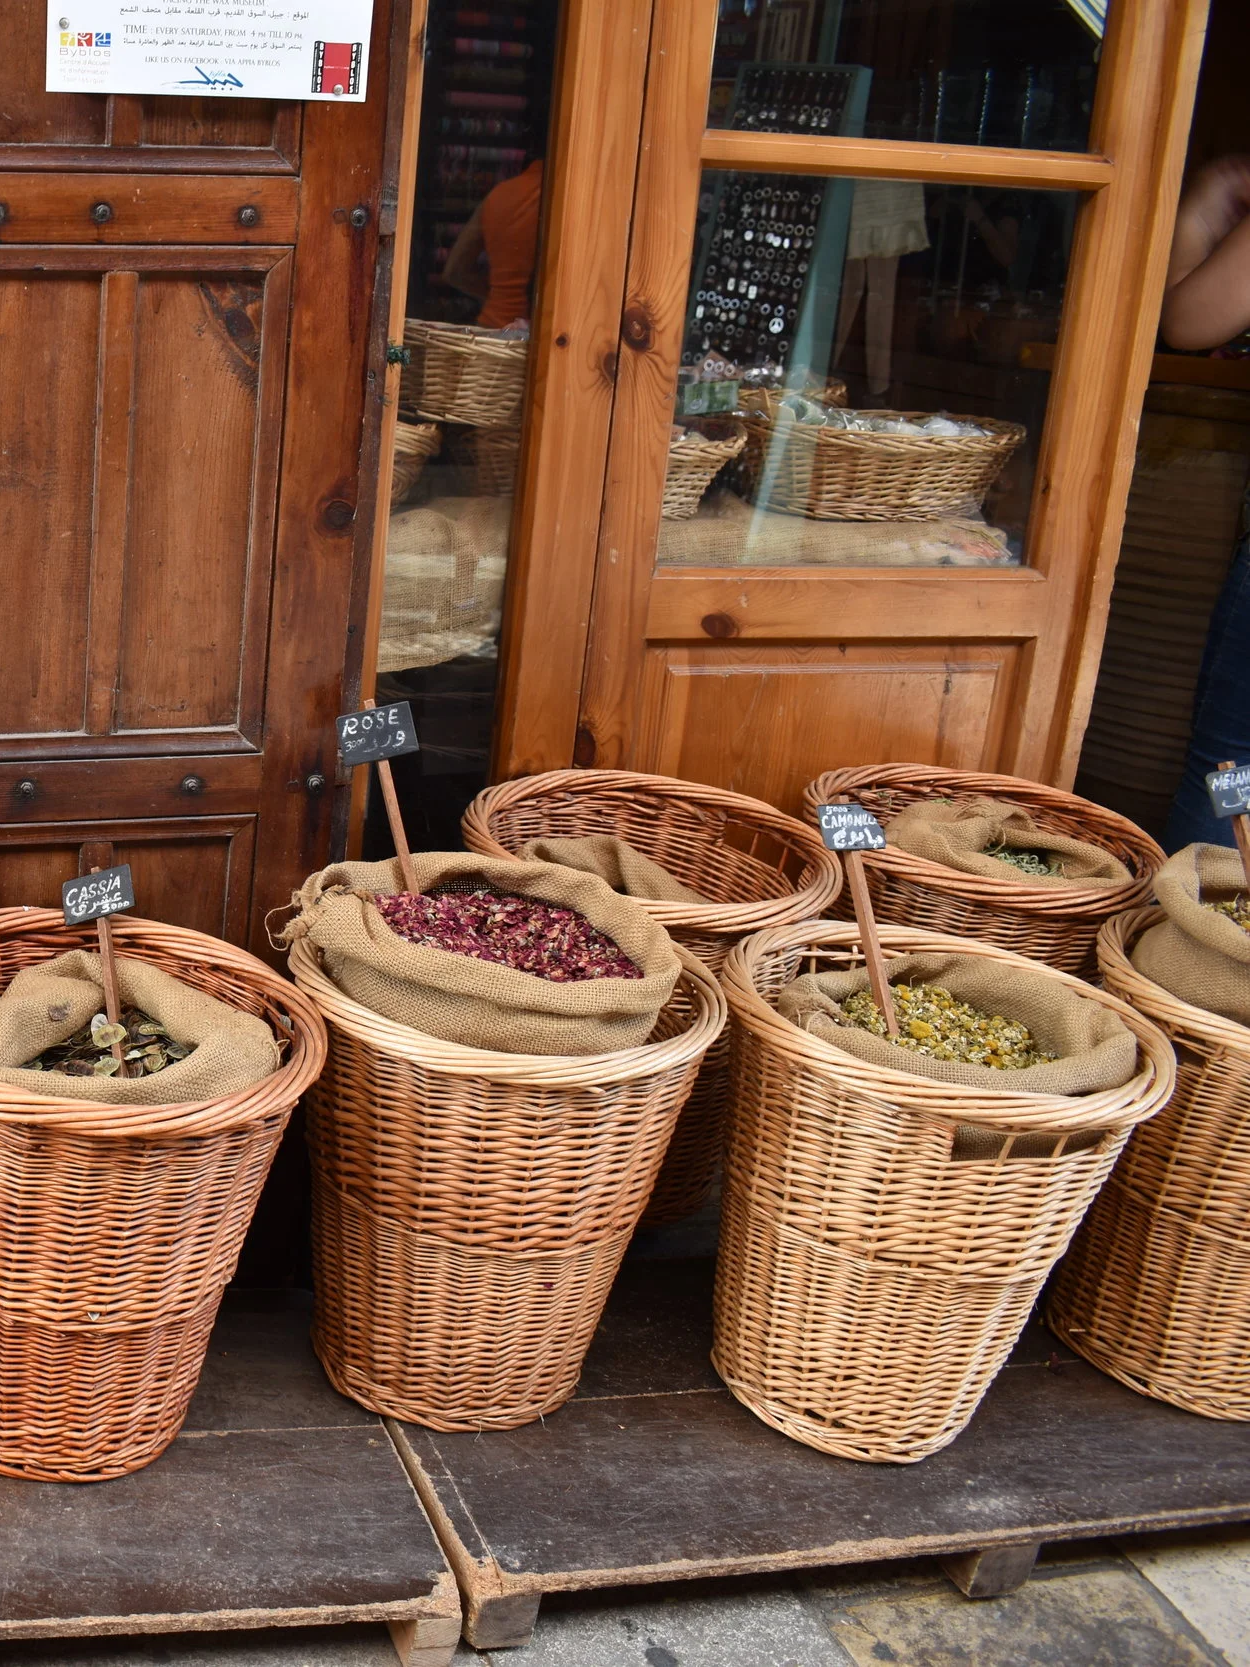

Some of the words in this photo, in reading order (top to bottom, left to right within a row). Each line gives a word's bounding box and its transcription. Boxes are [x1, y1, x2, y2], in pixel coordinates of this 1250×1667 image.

[123, 24, 147, 34] TIME
[155, 27, 179, 35] EVERY
[224, 29, 246, 37] FROM
[269, 30, 284, 38] TILL
[59, 47, 111, 57] Byblos
[170, 56, 183, 64] ON
[184, 56, 219, 64] FACEBOOK
[257, 59, 281, 67] BYBLOS
[316, 42, 325, 93] BYBLOS
[349, 44, 357, 94] BYBLOS
[342, 708, 399, 738] ROSE
[65, 873, 121, 907] CASSIA
